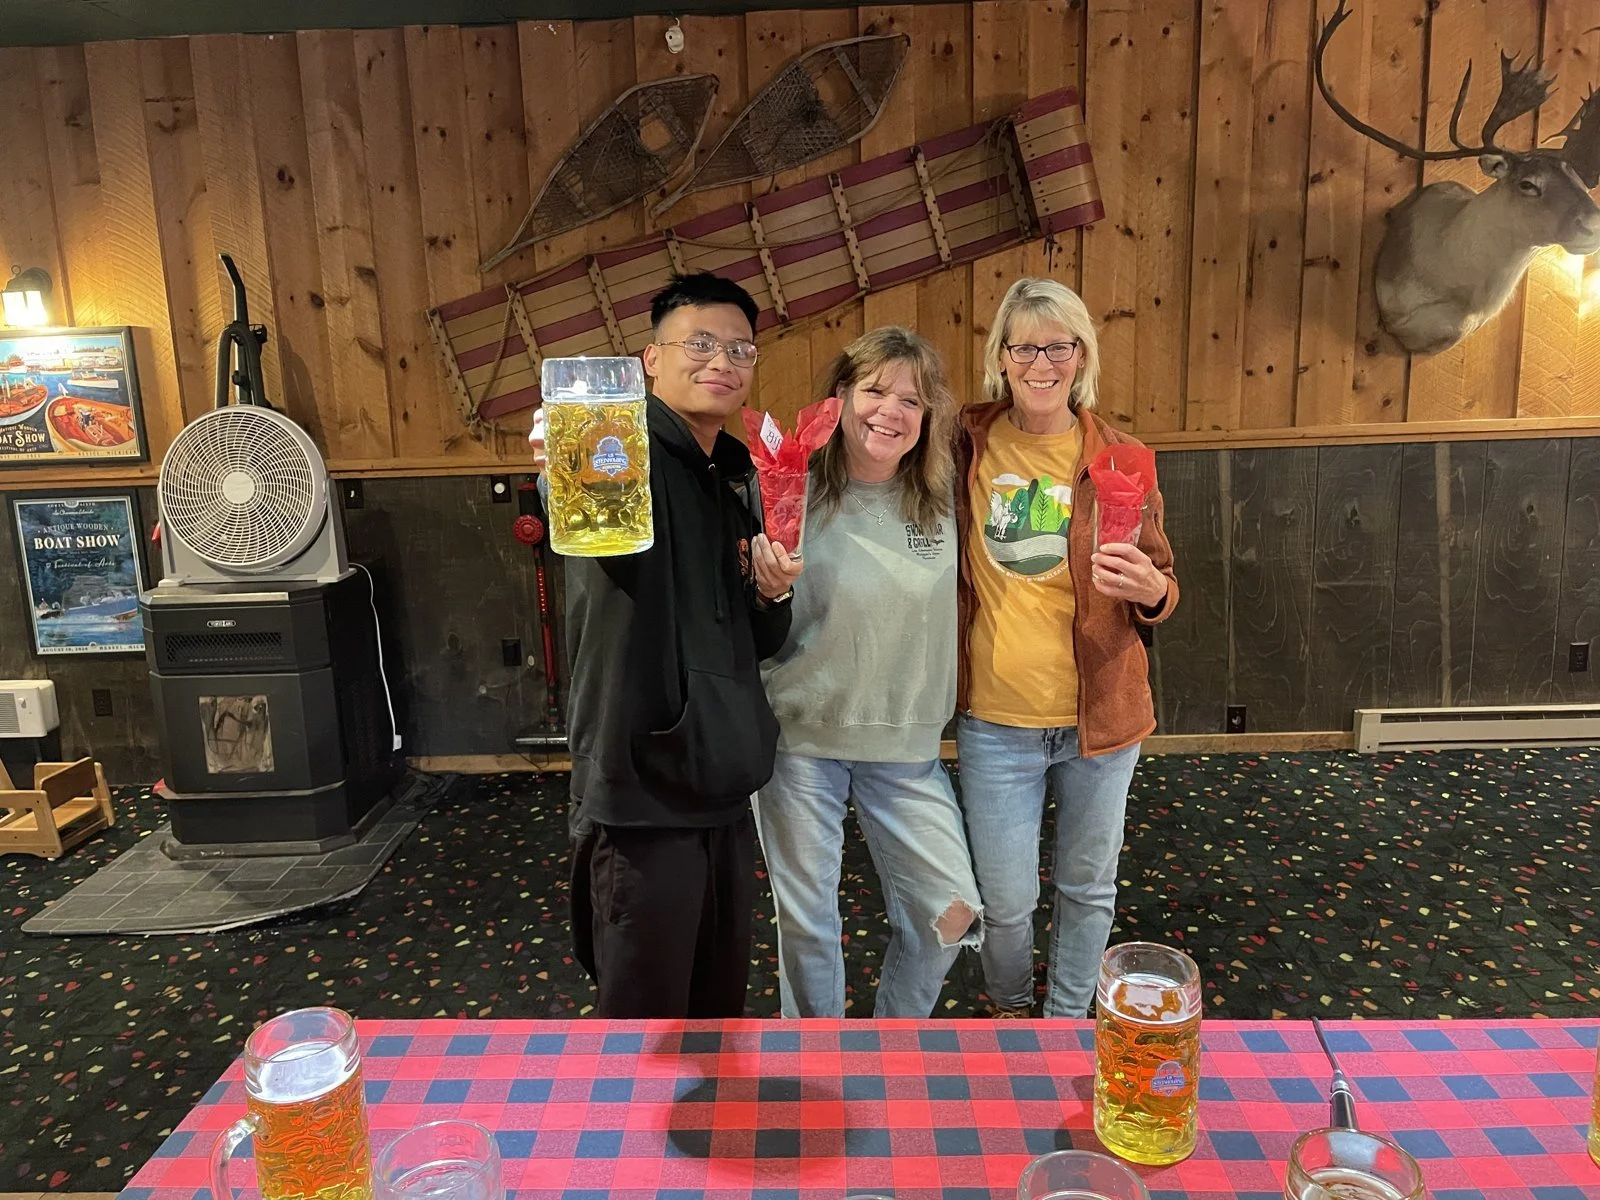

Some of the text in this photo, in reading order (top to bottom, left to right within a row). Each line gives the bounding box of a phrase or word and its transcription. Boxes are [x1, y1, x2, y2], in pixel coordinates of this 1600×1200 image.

[15, 430, 45, 448] SHOW
[43, 522, 109, 534] ANTIQUE WOODEN
[34, 534, 121, 550] BOAT SHOW
[907, 537, 913, 549] &
[1045, 562, 1068, 579] CLEANU
